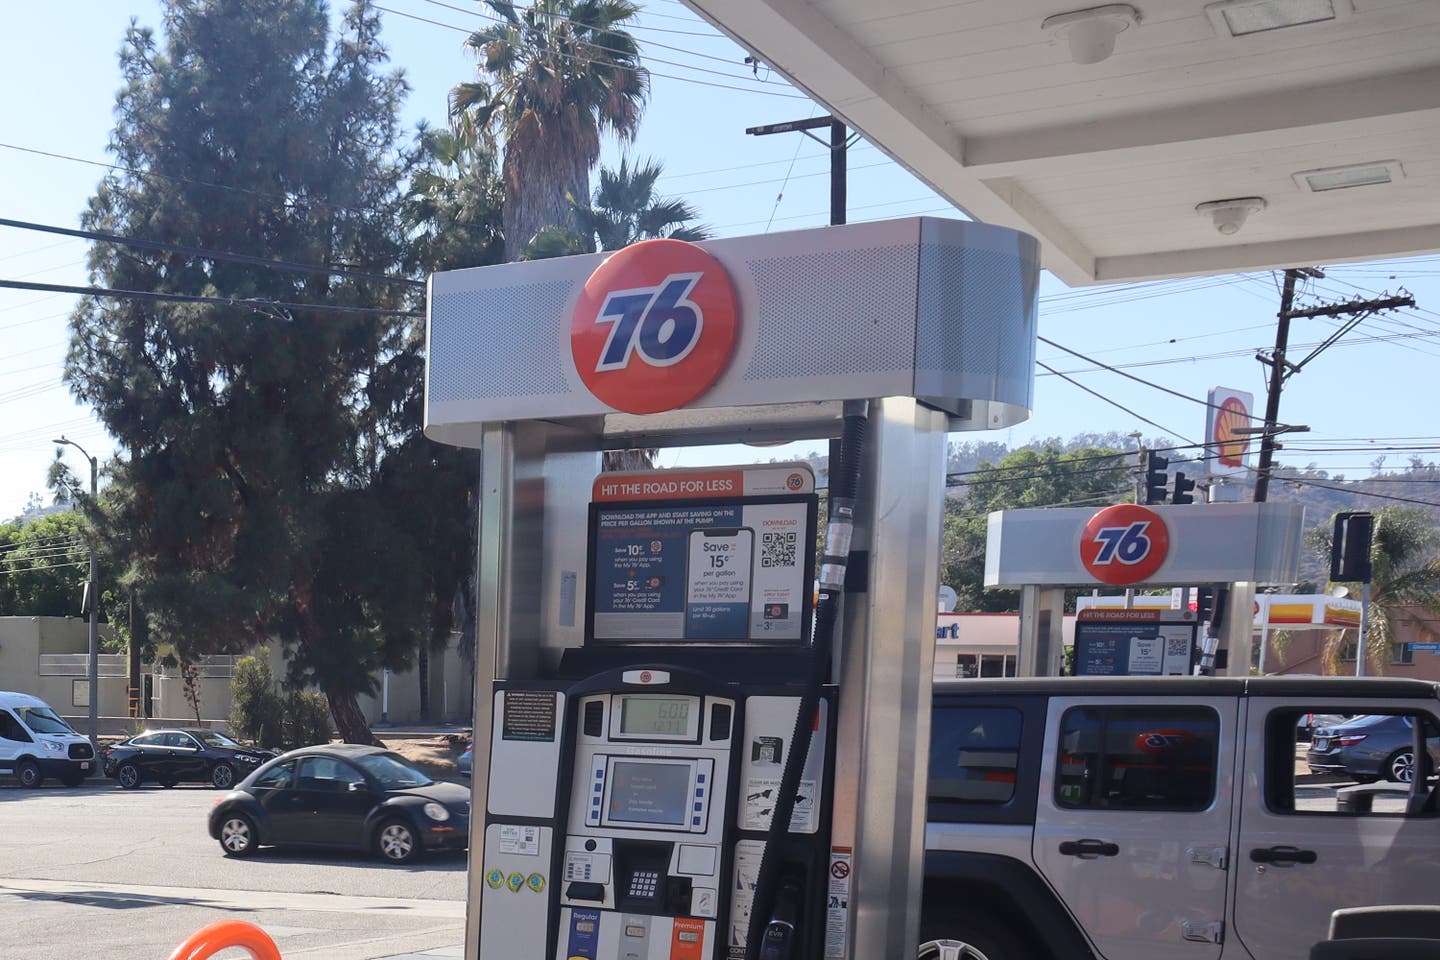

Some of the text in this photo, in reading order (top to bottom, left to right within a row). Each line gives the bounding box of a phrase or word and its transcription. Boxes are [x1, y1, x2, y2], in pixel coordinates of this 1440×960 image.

[594, 272, 704, 372] 76
[601, 484, 618, 496] HIT
[621, 484, 640, 494] THE
[643, 482, 677, 494] ROAD
[680, 481, 703, 492] FOR
[706, 480, 733, 491] LESS
[704, 542, 729, 552] Save
[1092, 521, 1152, 565] 76
[573, 912, 598, 921] Regular
[675, 922, 704, 930] Premium
